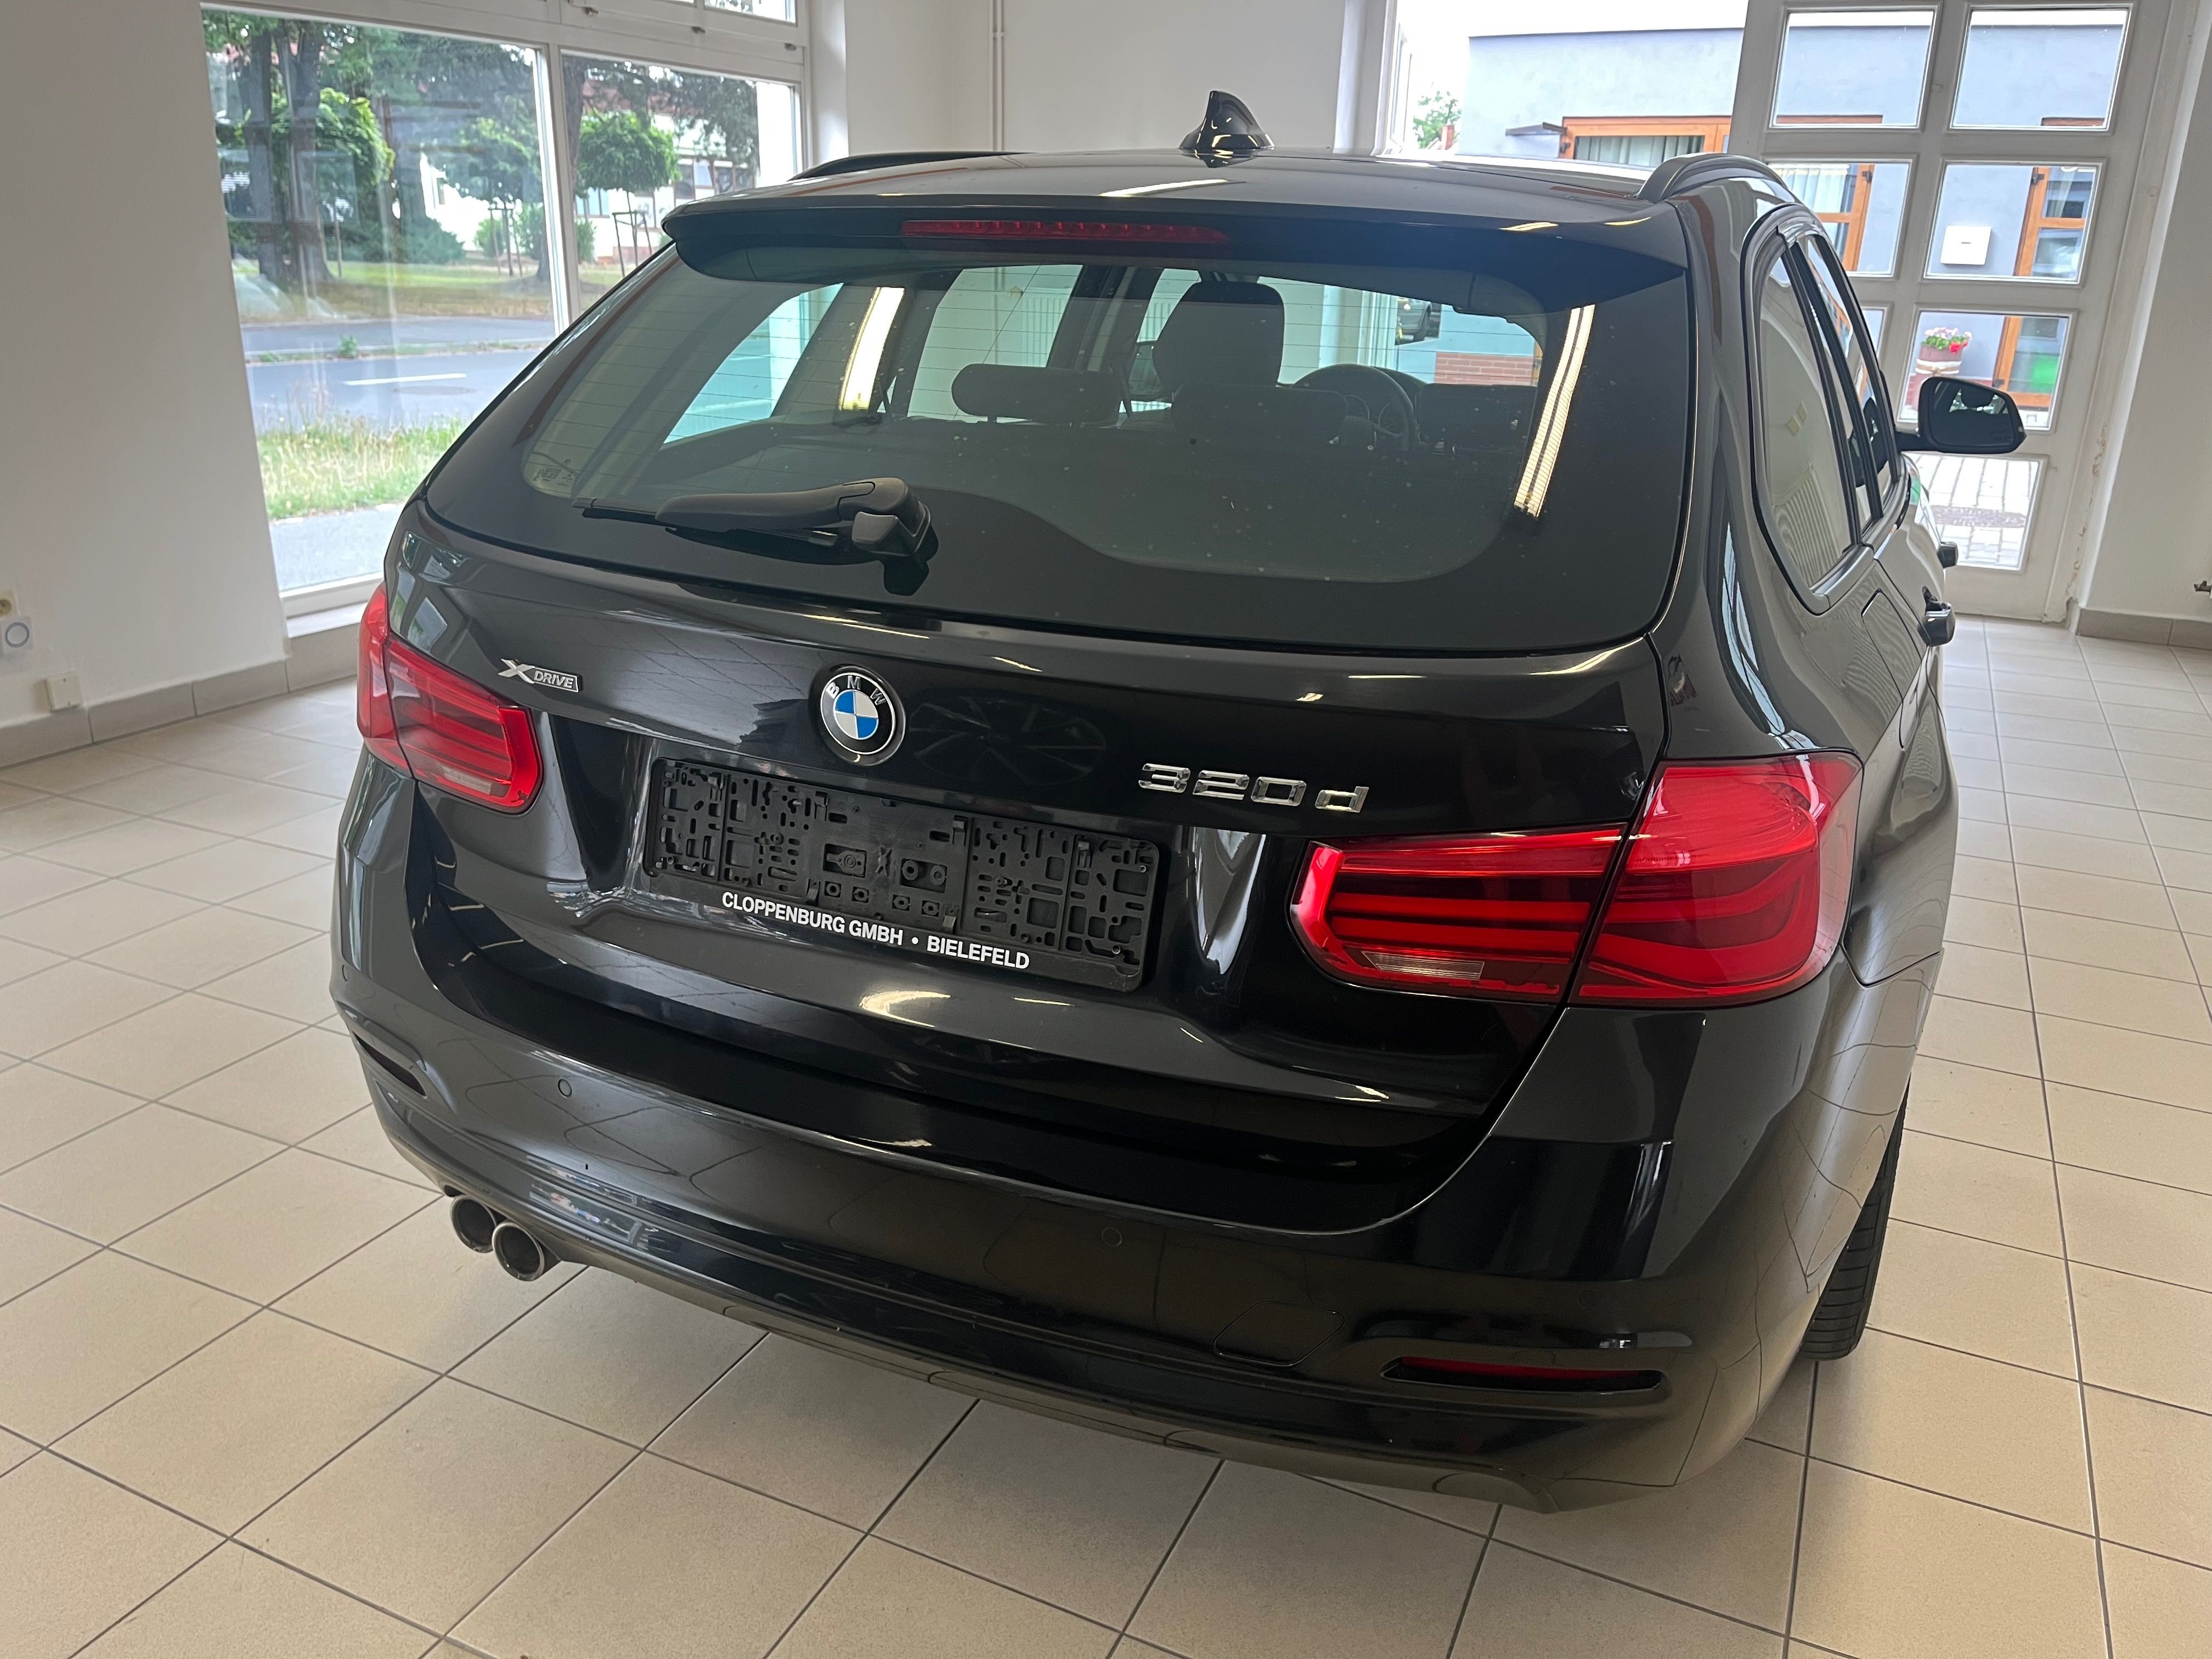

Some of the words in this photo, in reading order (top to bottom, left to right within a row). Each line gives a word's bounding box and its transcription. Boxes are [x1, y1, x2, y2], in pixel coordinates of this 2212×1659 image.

[826, 675, 887, 706] BMW
[1138, 763, 1370, 813] 320d
[722, 891, 845, 933] CLOPPENBURG
[849, 919, 903, 946] GMBH
[927, 935, 1030, 969] BIELEFELD
